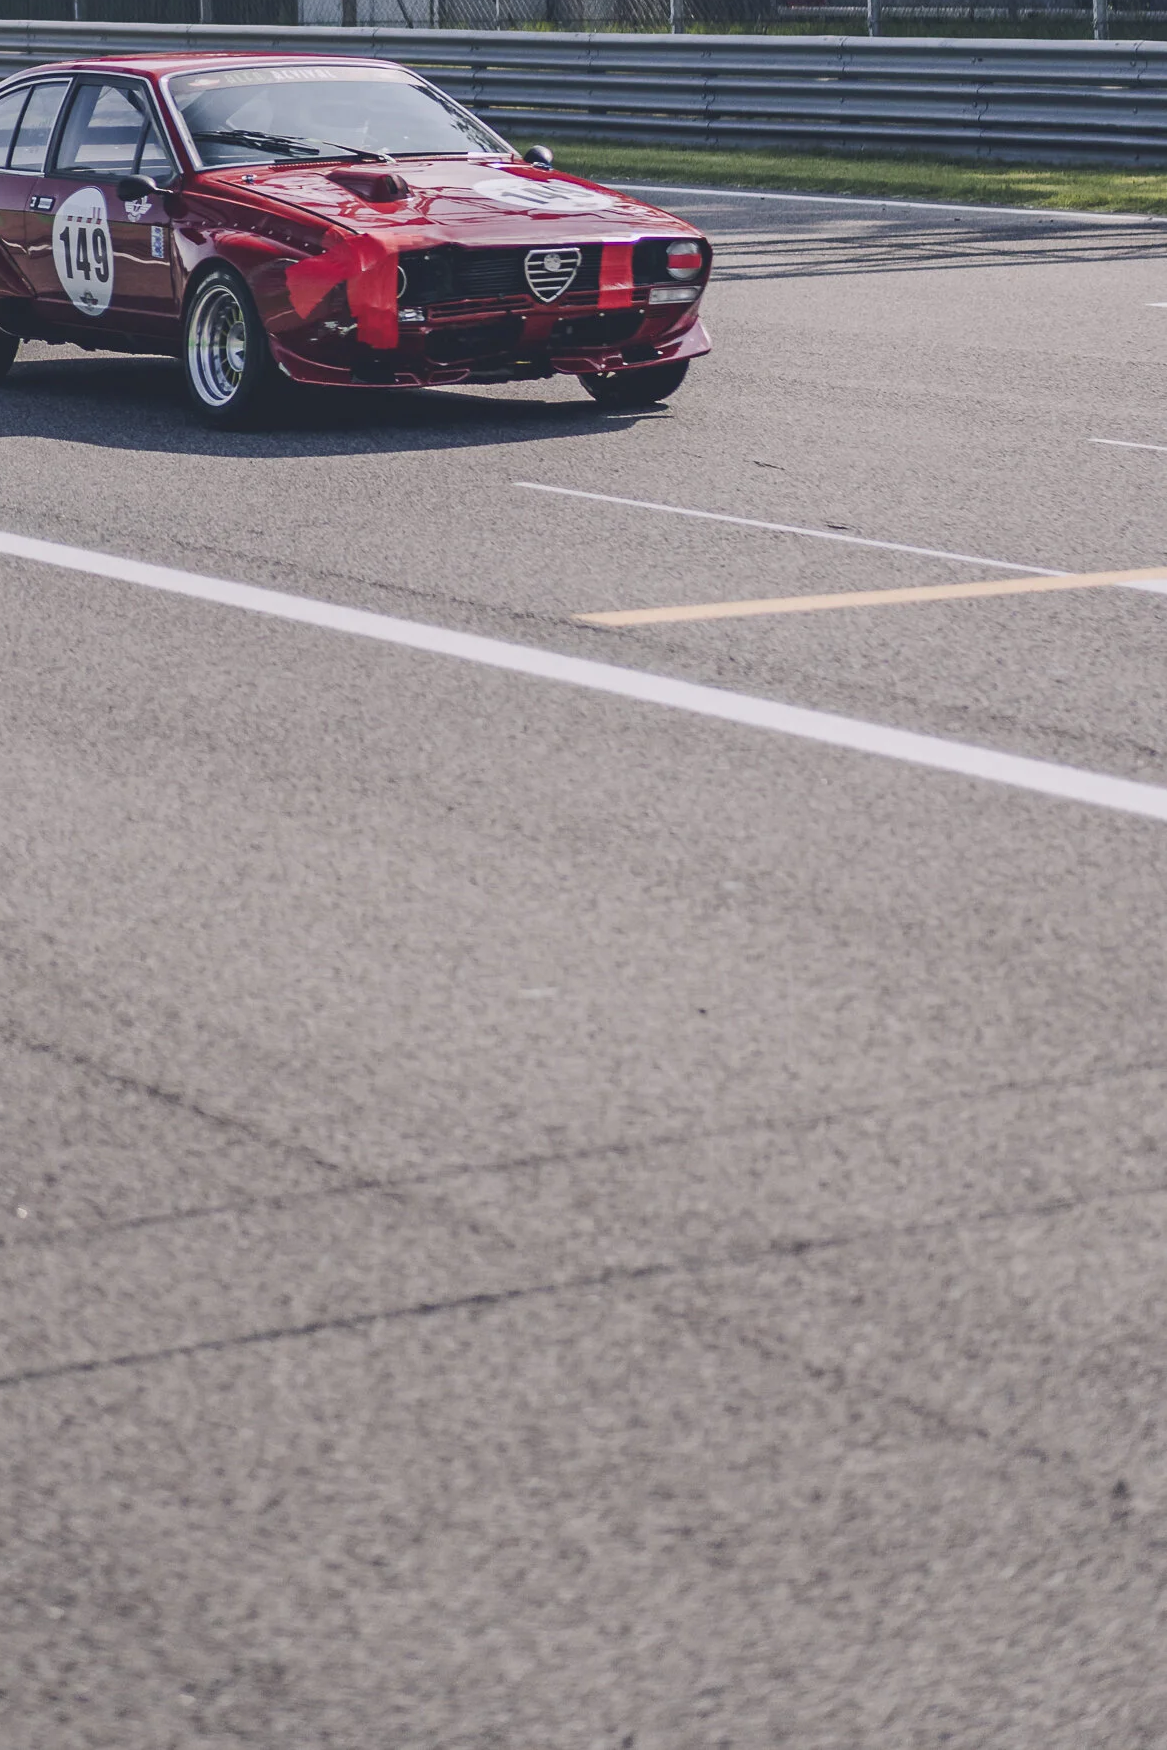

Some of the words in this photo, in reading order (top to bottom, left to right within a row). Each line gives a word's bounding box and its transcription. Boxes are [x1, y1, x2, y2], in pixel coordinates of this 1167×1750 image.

[270, 69, 338, 81] REVIVAL
[502, 183, 594, 204] 149
[59, 226, 109, 283] 149
